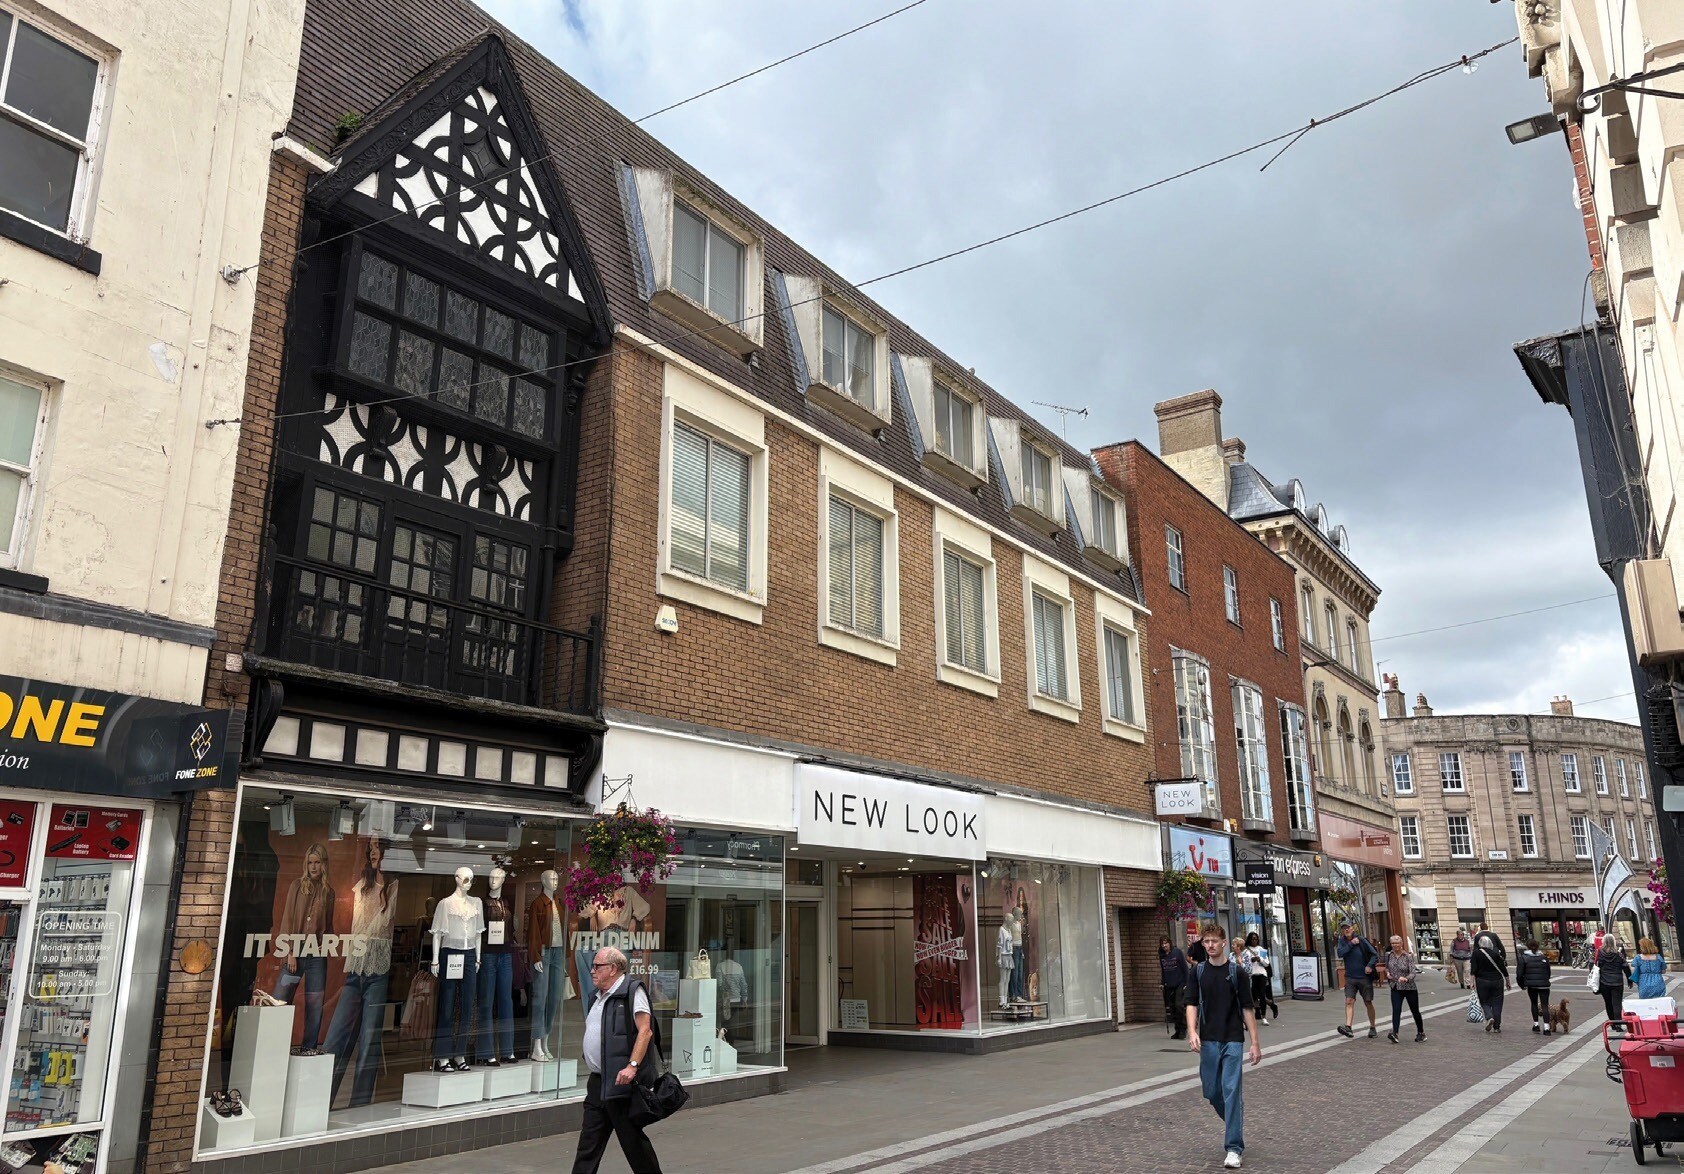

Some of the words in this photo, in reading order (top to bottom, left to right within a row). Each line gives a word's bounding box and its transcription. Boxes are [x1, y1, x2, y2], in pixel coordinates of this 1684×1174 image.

[175, 768, 197, 780] FONE
[196, 765, 219, 778] ZONE
[1163, 790, 1191, 799] NEW
[1161, 799, 1195, 809] LOOK
[814, 789, 888, 829] NEW
[906, 803, 978, 841] LOOK
[53, 824, 75, 832] Batteries
[1206, 857, 1219, 874] TUI
[1285, 855, 1311, 879] express
[1250, 871, 1269, 879] vision
[1247, 879, 1273, 887] express
[1538, 892, 1585, 904] F.HINDS
[45, 922, 90, 930] OPENING
[93, 921, 115, 930] TIME
[243, 933, 272, 958] IT
[272, 933, 368, 958] STARTS
[607, 931, 660, 951] DENIM
[40, 944, 71, 952] Monday
[42, 955, 59, 963] 9.00
[58, 970, 90, 978] Sunday:
[629, 964, 659, 975] £16.99
[78, 979, 94, 987] 5.00
